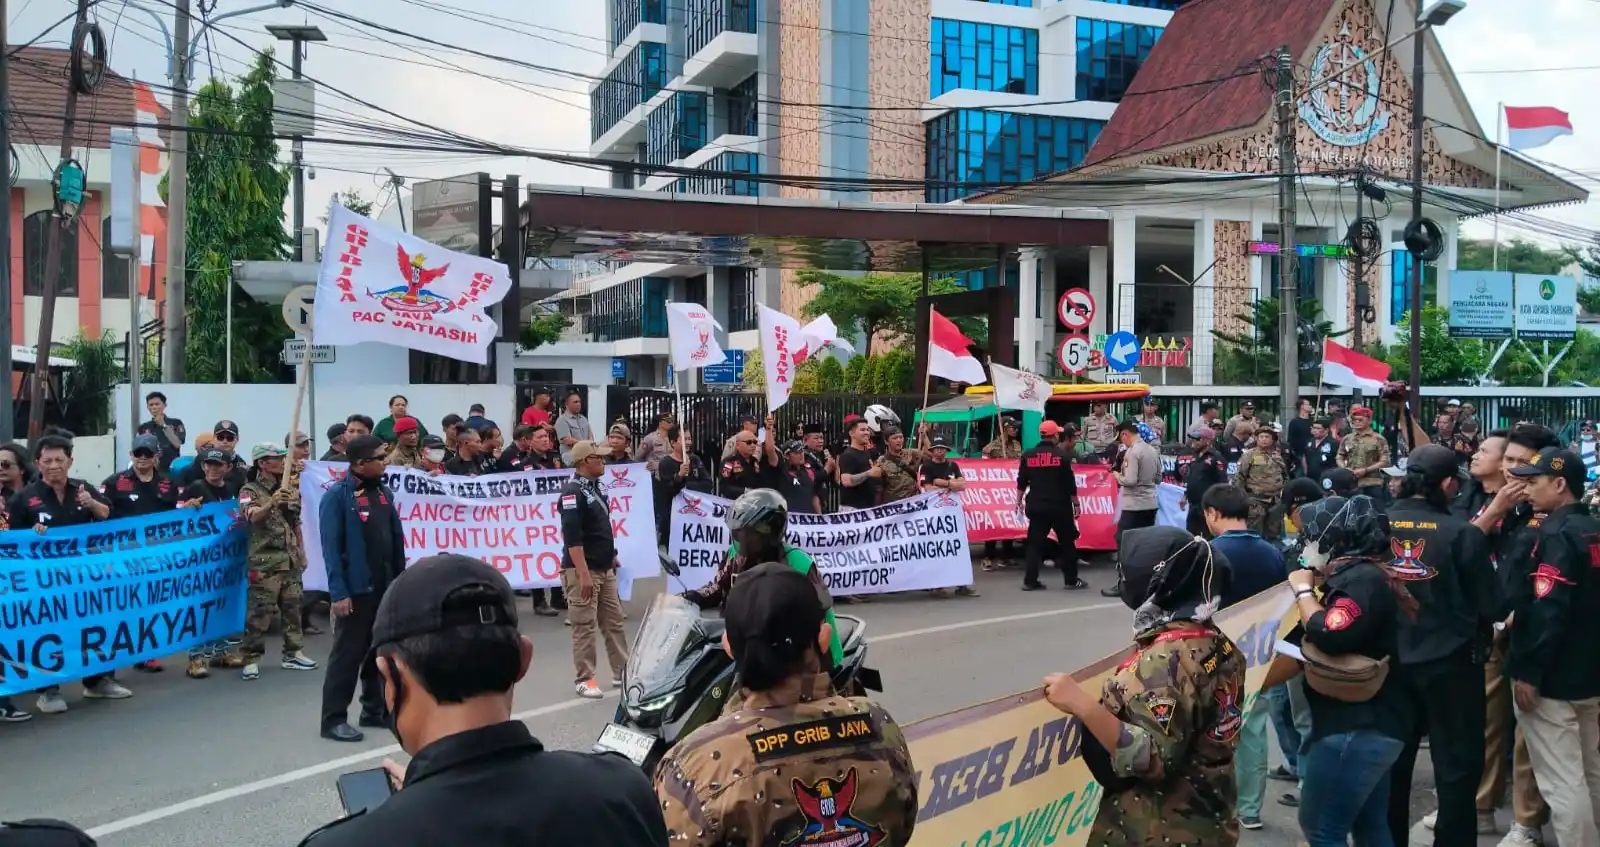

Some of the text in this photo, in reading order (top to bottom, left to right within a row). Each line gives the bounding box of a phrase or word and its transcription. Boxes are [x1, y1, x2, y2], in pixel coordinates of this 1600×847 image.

[352, 311, 478, 345] PAC JATIASIH
[1068, 343, 1079, 366] 5
[489, 477, 533, 498] KOTA
[962, 487, 991, 505] UNG
[399, 503, 467, 523] LANCE
[472, 503, 544, 523] UNTUK
[965, 510, 996, 531] NPA
[144, 514, 221, 546] BEKASI
[434, 526, 518, 550] UNTUK
[682, 522, 723, 544] KAMI
[805, 526, 860, 549] KEJARI
[863, 522, 901, 545] KOTA
[904, 515, 958, 539] BEKASI
[812, 547, 878, 570] ESIONAL
[880, 539, 962, 563] MENANGKAP
[0, 570, 28, 596] CE
[36, 559, 122, 589] UNTUK
[822, 567, 895, 590] ORUPTOR”
[0, 593, 68, 631] UKAN
[73, 581, 143, 618] UNTUK
[0, 633, 65, 684] NG
[755, 719, 871, 753] DPP GRIB JAYA
[819, 797, 836, 816] GRIB
